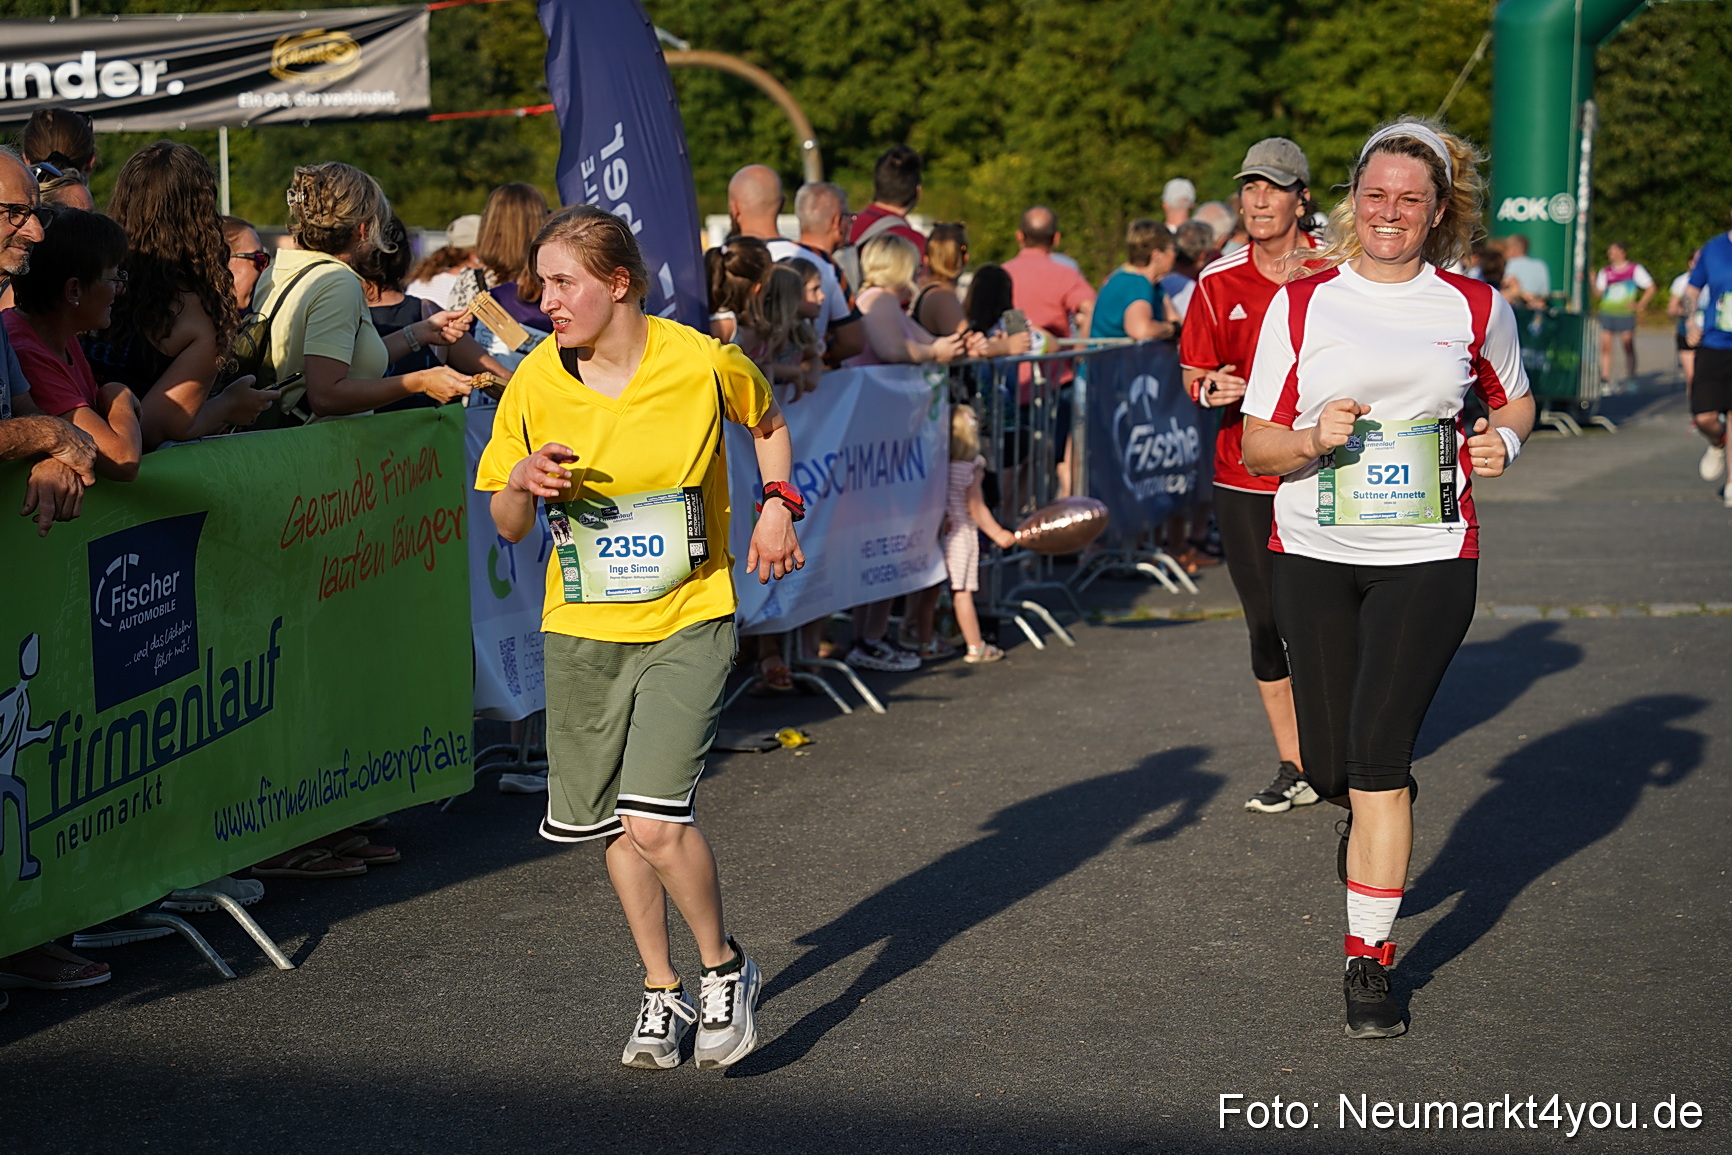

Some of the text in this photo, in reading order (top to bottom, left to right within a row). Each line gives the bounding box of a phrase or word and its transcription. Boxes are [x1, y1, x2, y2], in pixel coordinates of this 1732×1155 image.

[0, 51, 185, 99] nder.
[1496, 197, 1549, 222] AOK
[1366, 464, 1409, 485] 521
[281, 446, 443, 549] Gesunde Firmen
[685, 493, 693, 520] RABATT
[1353, 490, 1426, 500] Suttner Annette
[1443, 485, 1451, 516] HILTL
[596, 534, 664, 558] 2350
[688, 526, 694, 537] 20
[318, 529, 385, 602] laufen
[609, 564, 660, 575] Inge Simon
[111, 570, 180, 617] Fischer
[118, 599, 176, 632] AUTOMOBILE
[48, 615, 283, 814] firmenlauf
[55, 773, 163, 859] neumarkt
